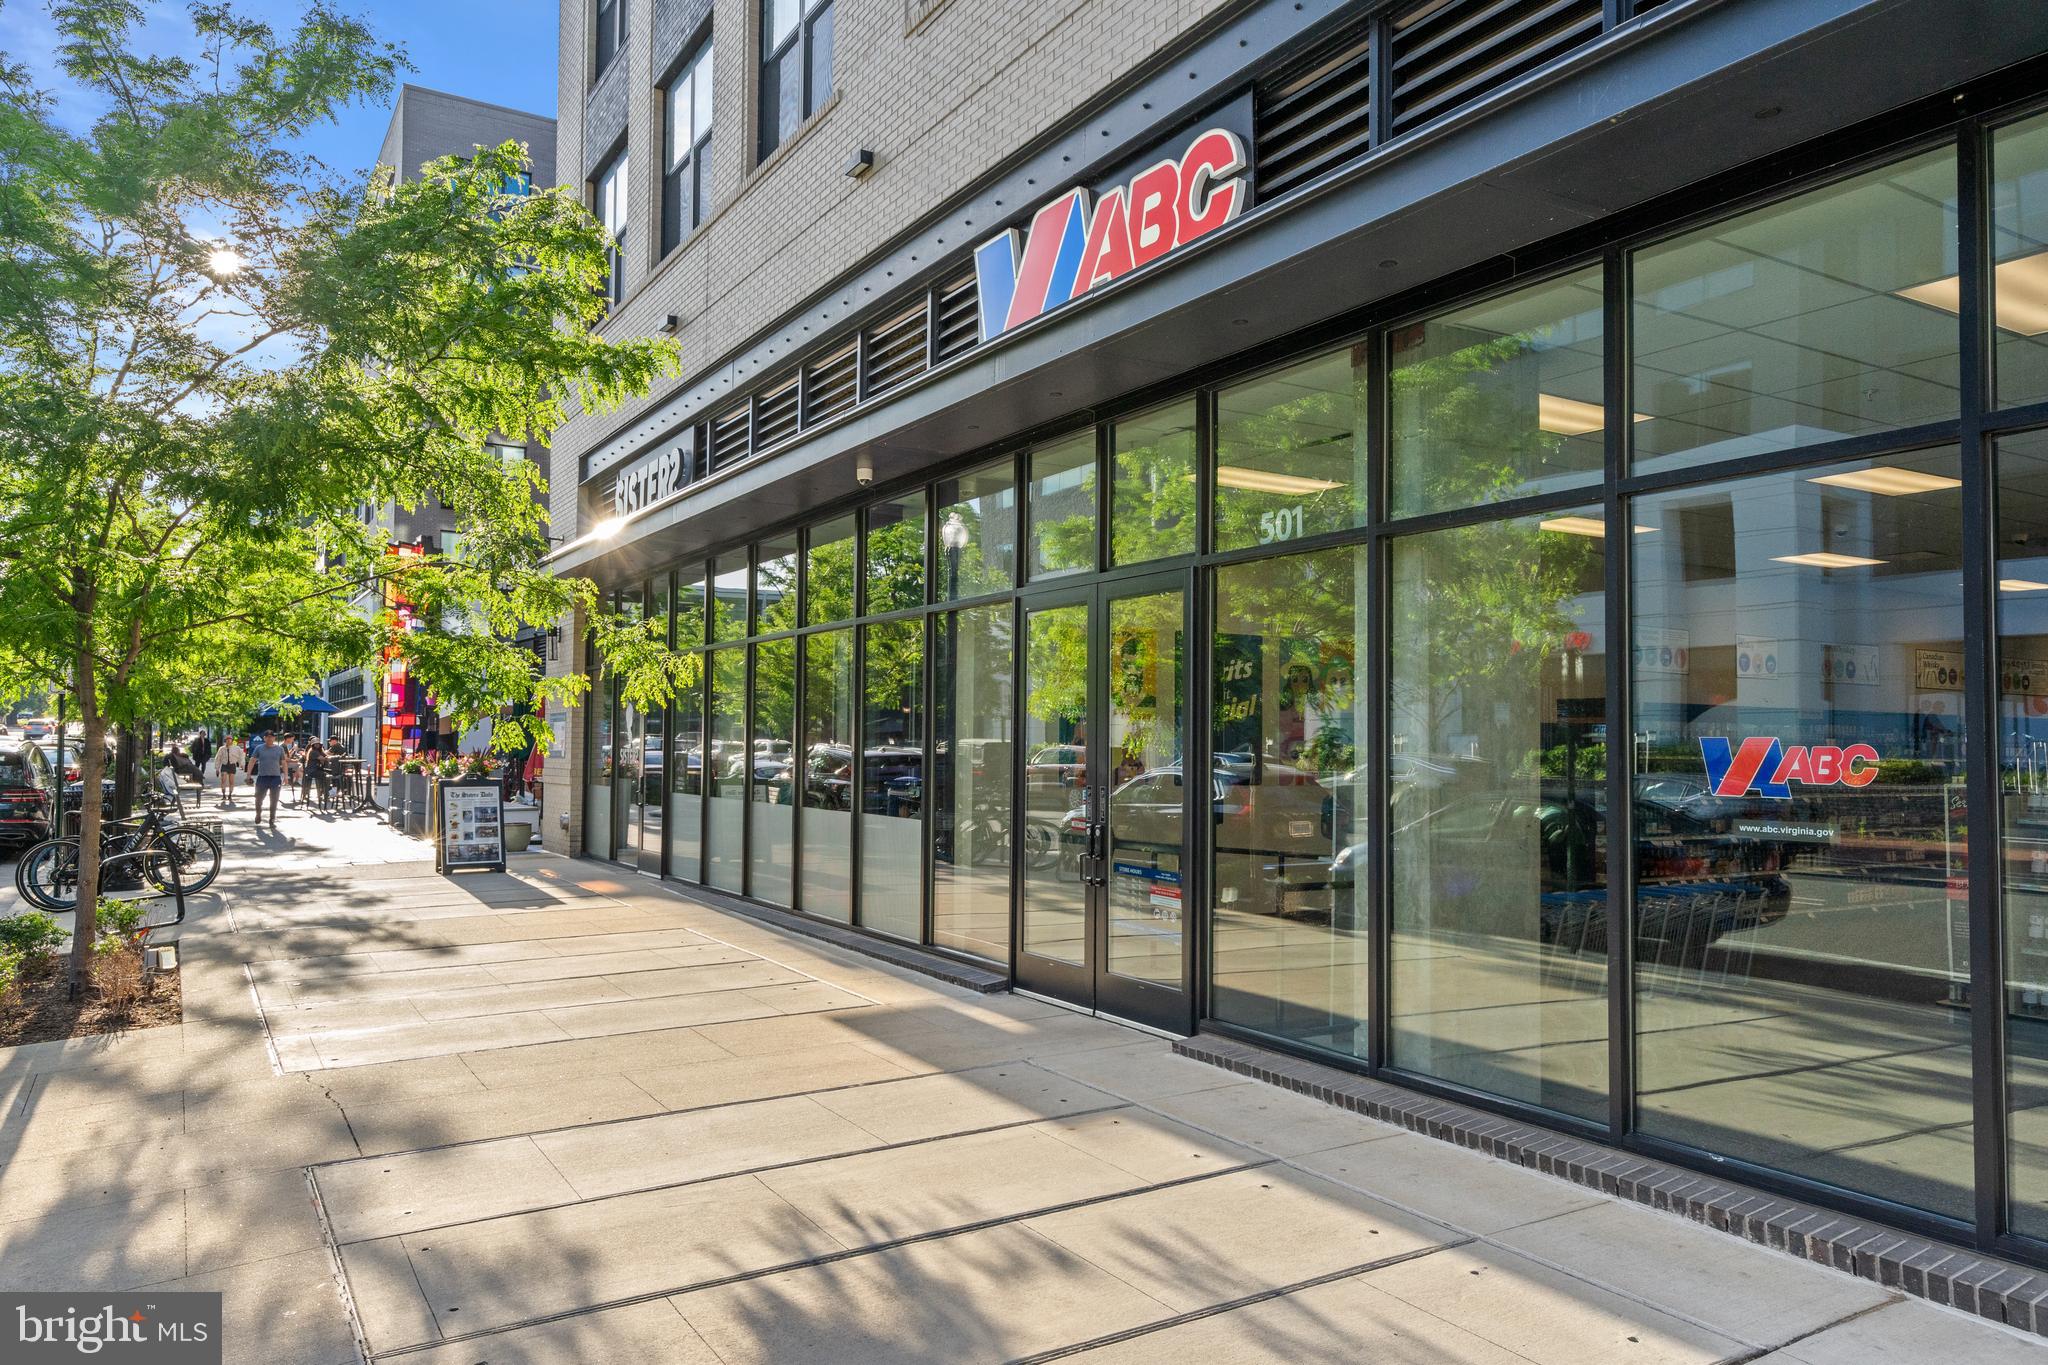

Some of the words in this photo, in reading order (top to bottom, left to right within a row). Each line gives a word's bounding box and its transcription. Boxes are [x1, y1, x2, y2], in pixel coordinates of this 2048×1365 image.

[1070, 128, 1246, 299] ABC
[615, 447, 684, 520] SISTERS
[1259, 505, 1303, 545] 501
[1223, 659, 1253, 682] rits
[1769, 743, 1880, 787] ABC
[1738, 824, 1834, 838] www.abc.virginia.gov
